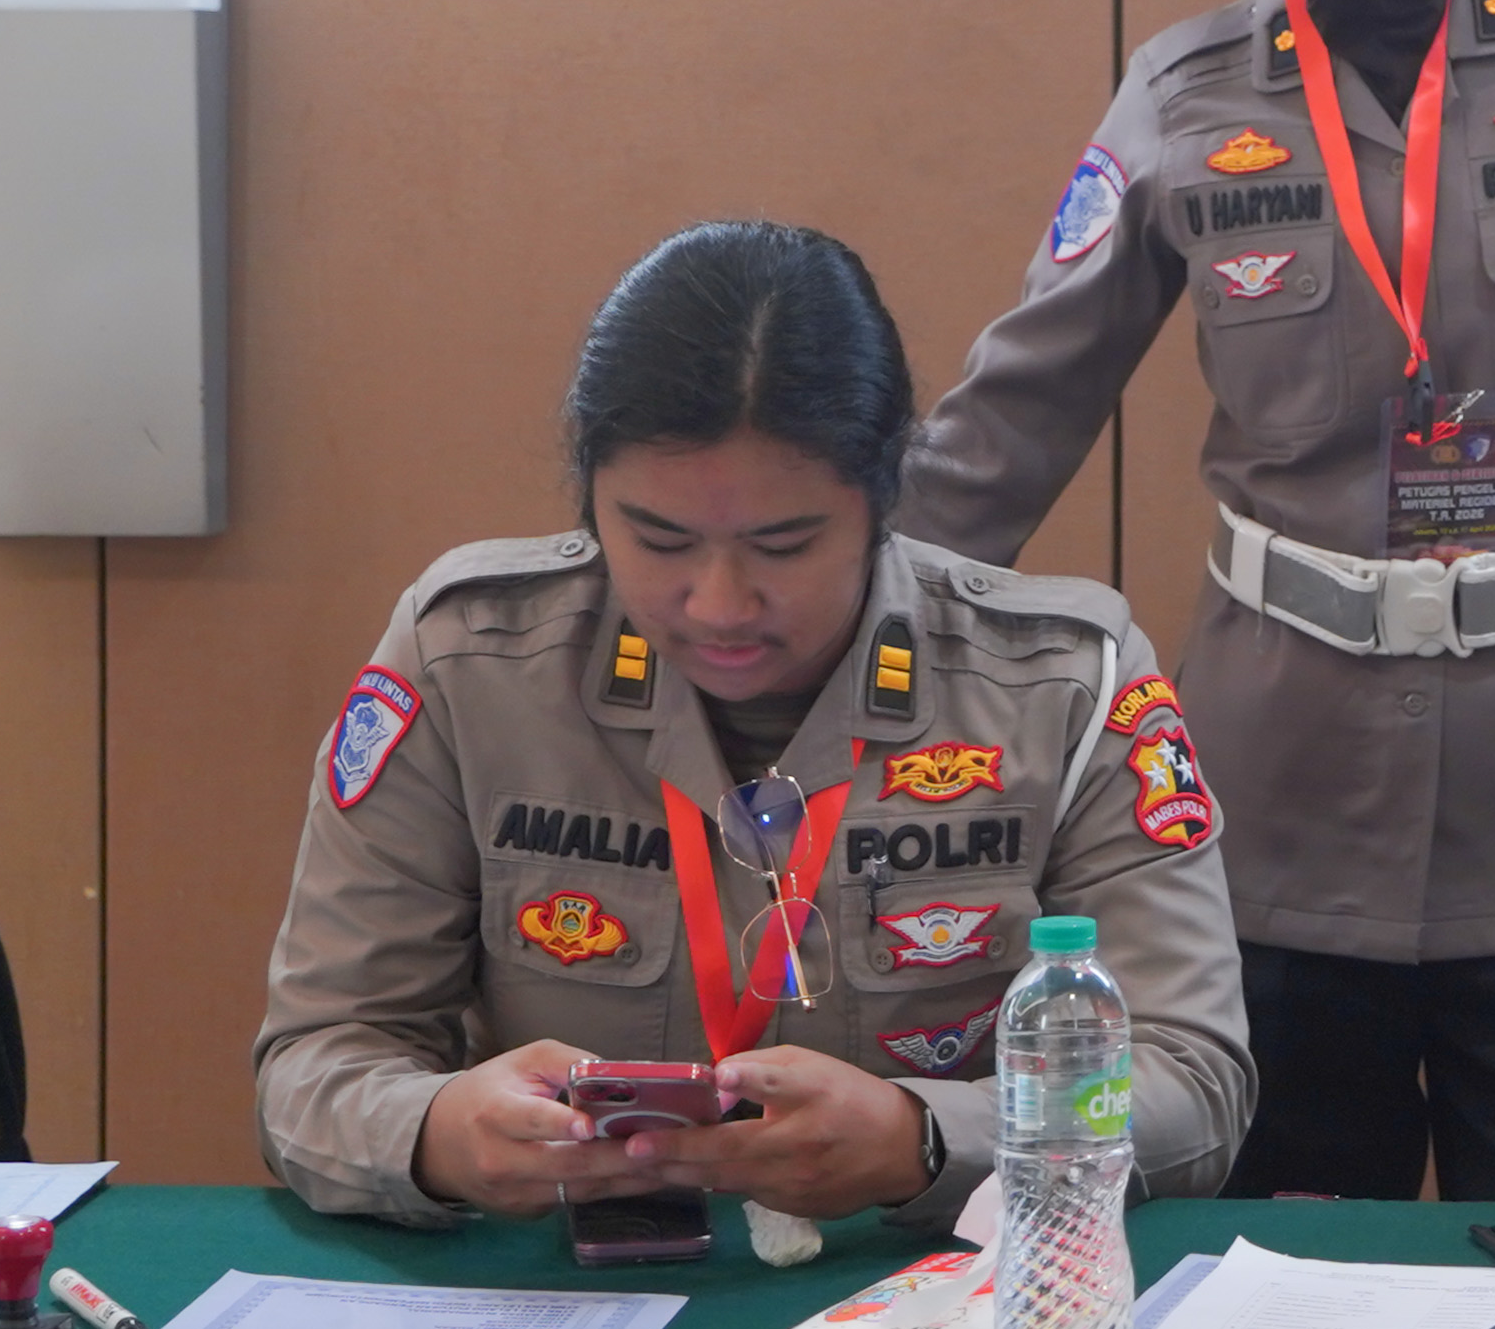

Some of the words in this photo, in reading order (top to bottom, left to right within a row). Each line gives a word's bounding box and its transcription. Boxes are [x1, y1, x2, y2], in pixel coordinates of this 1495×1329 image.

[1186, 193, 1204, 237] U
[1210, 183, 1323, 232] HARYANI
[1398, 485, 1450, 497] PETUGAS
[1401, 498, 1455, 510] MATERIEL
[1429, 511, 1451, 521] T.A.
[1455, 509, 1485, 520] 2026
[378, 674, 413, 712] LINTAS
[1144, 801, 1182, 831] MABES
[493, 803, 671, 871] AMALIA
[846, 817, 1022, 874] POLRI
